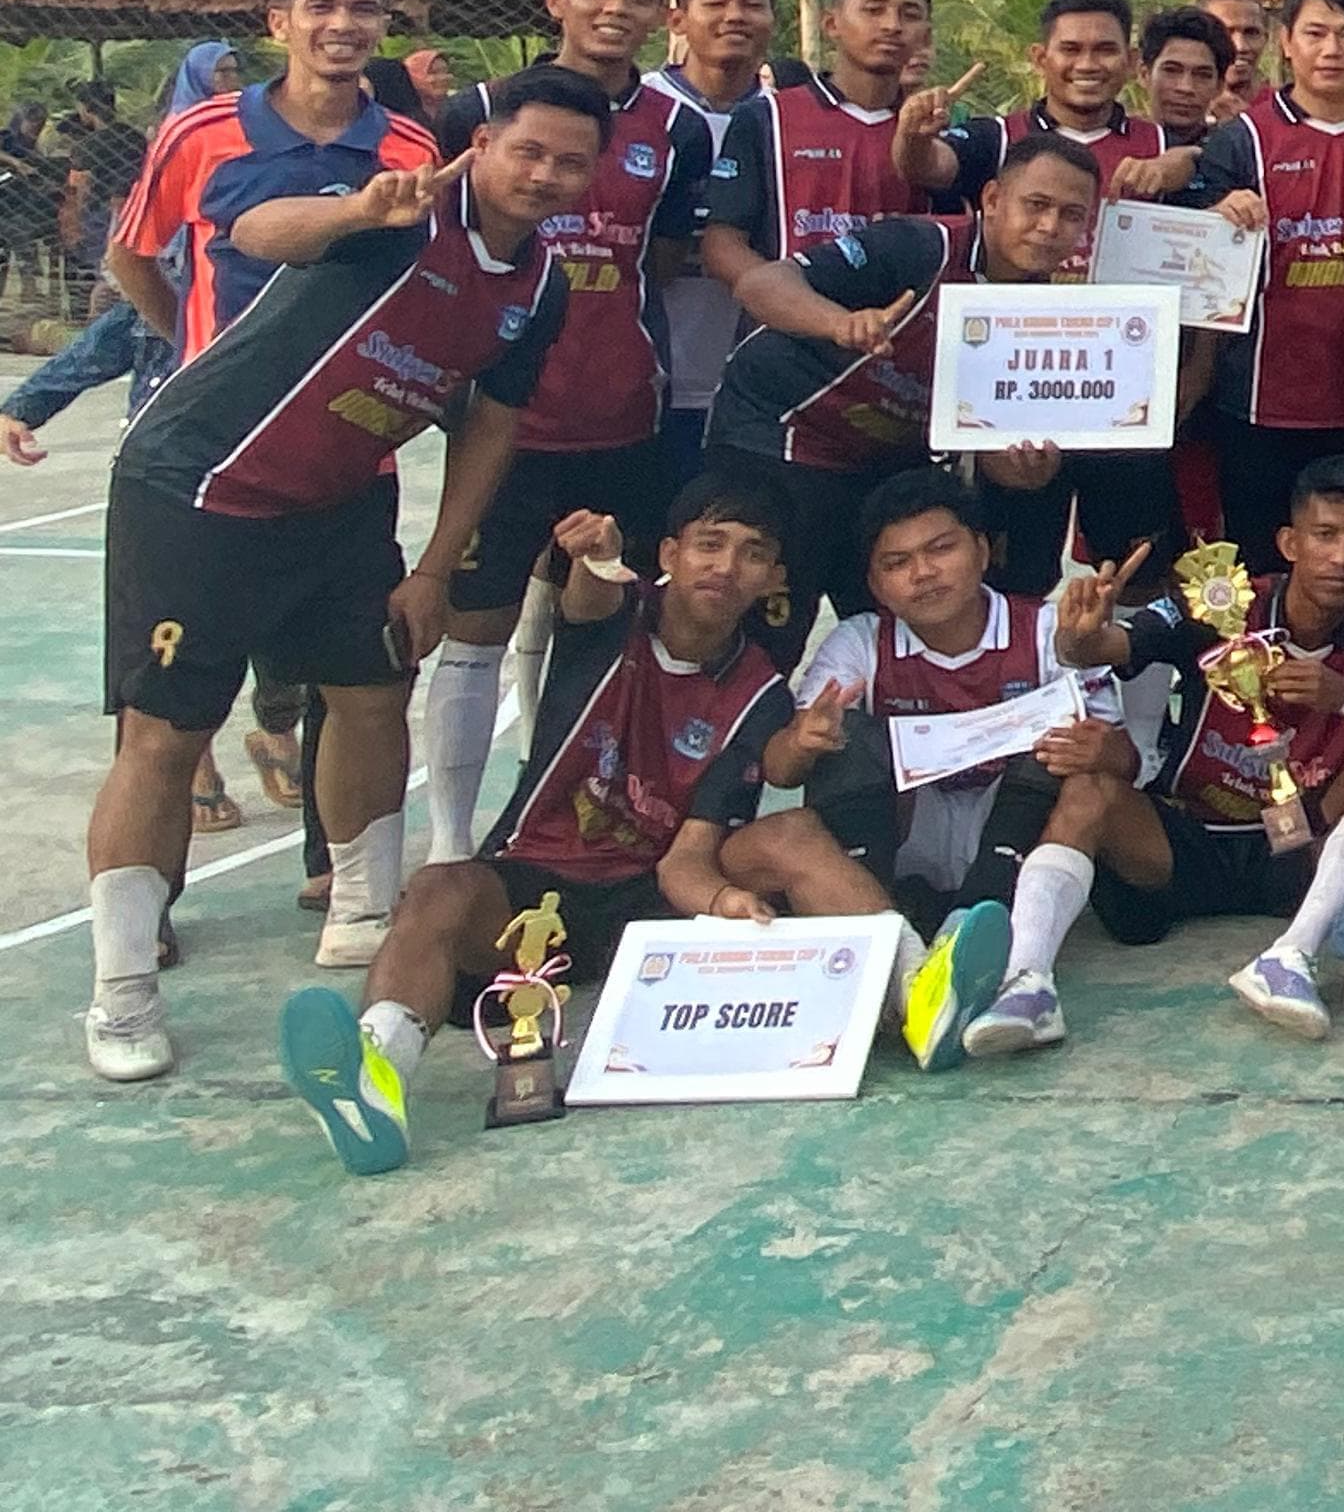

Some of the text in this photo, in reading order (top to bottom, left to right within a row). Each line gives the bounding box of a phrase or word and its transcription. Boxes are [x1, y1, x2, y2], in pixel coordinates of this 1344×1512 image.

[1007, 349, 1114, 371] JUARA 1
[1027, 380, 1116, 400] 3000.000
[151, 619, 184, 668] 9
[660, 1001, 800, 1032] TOP SCORE
